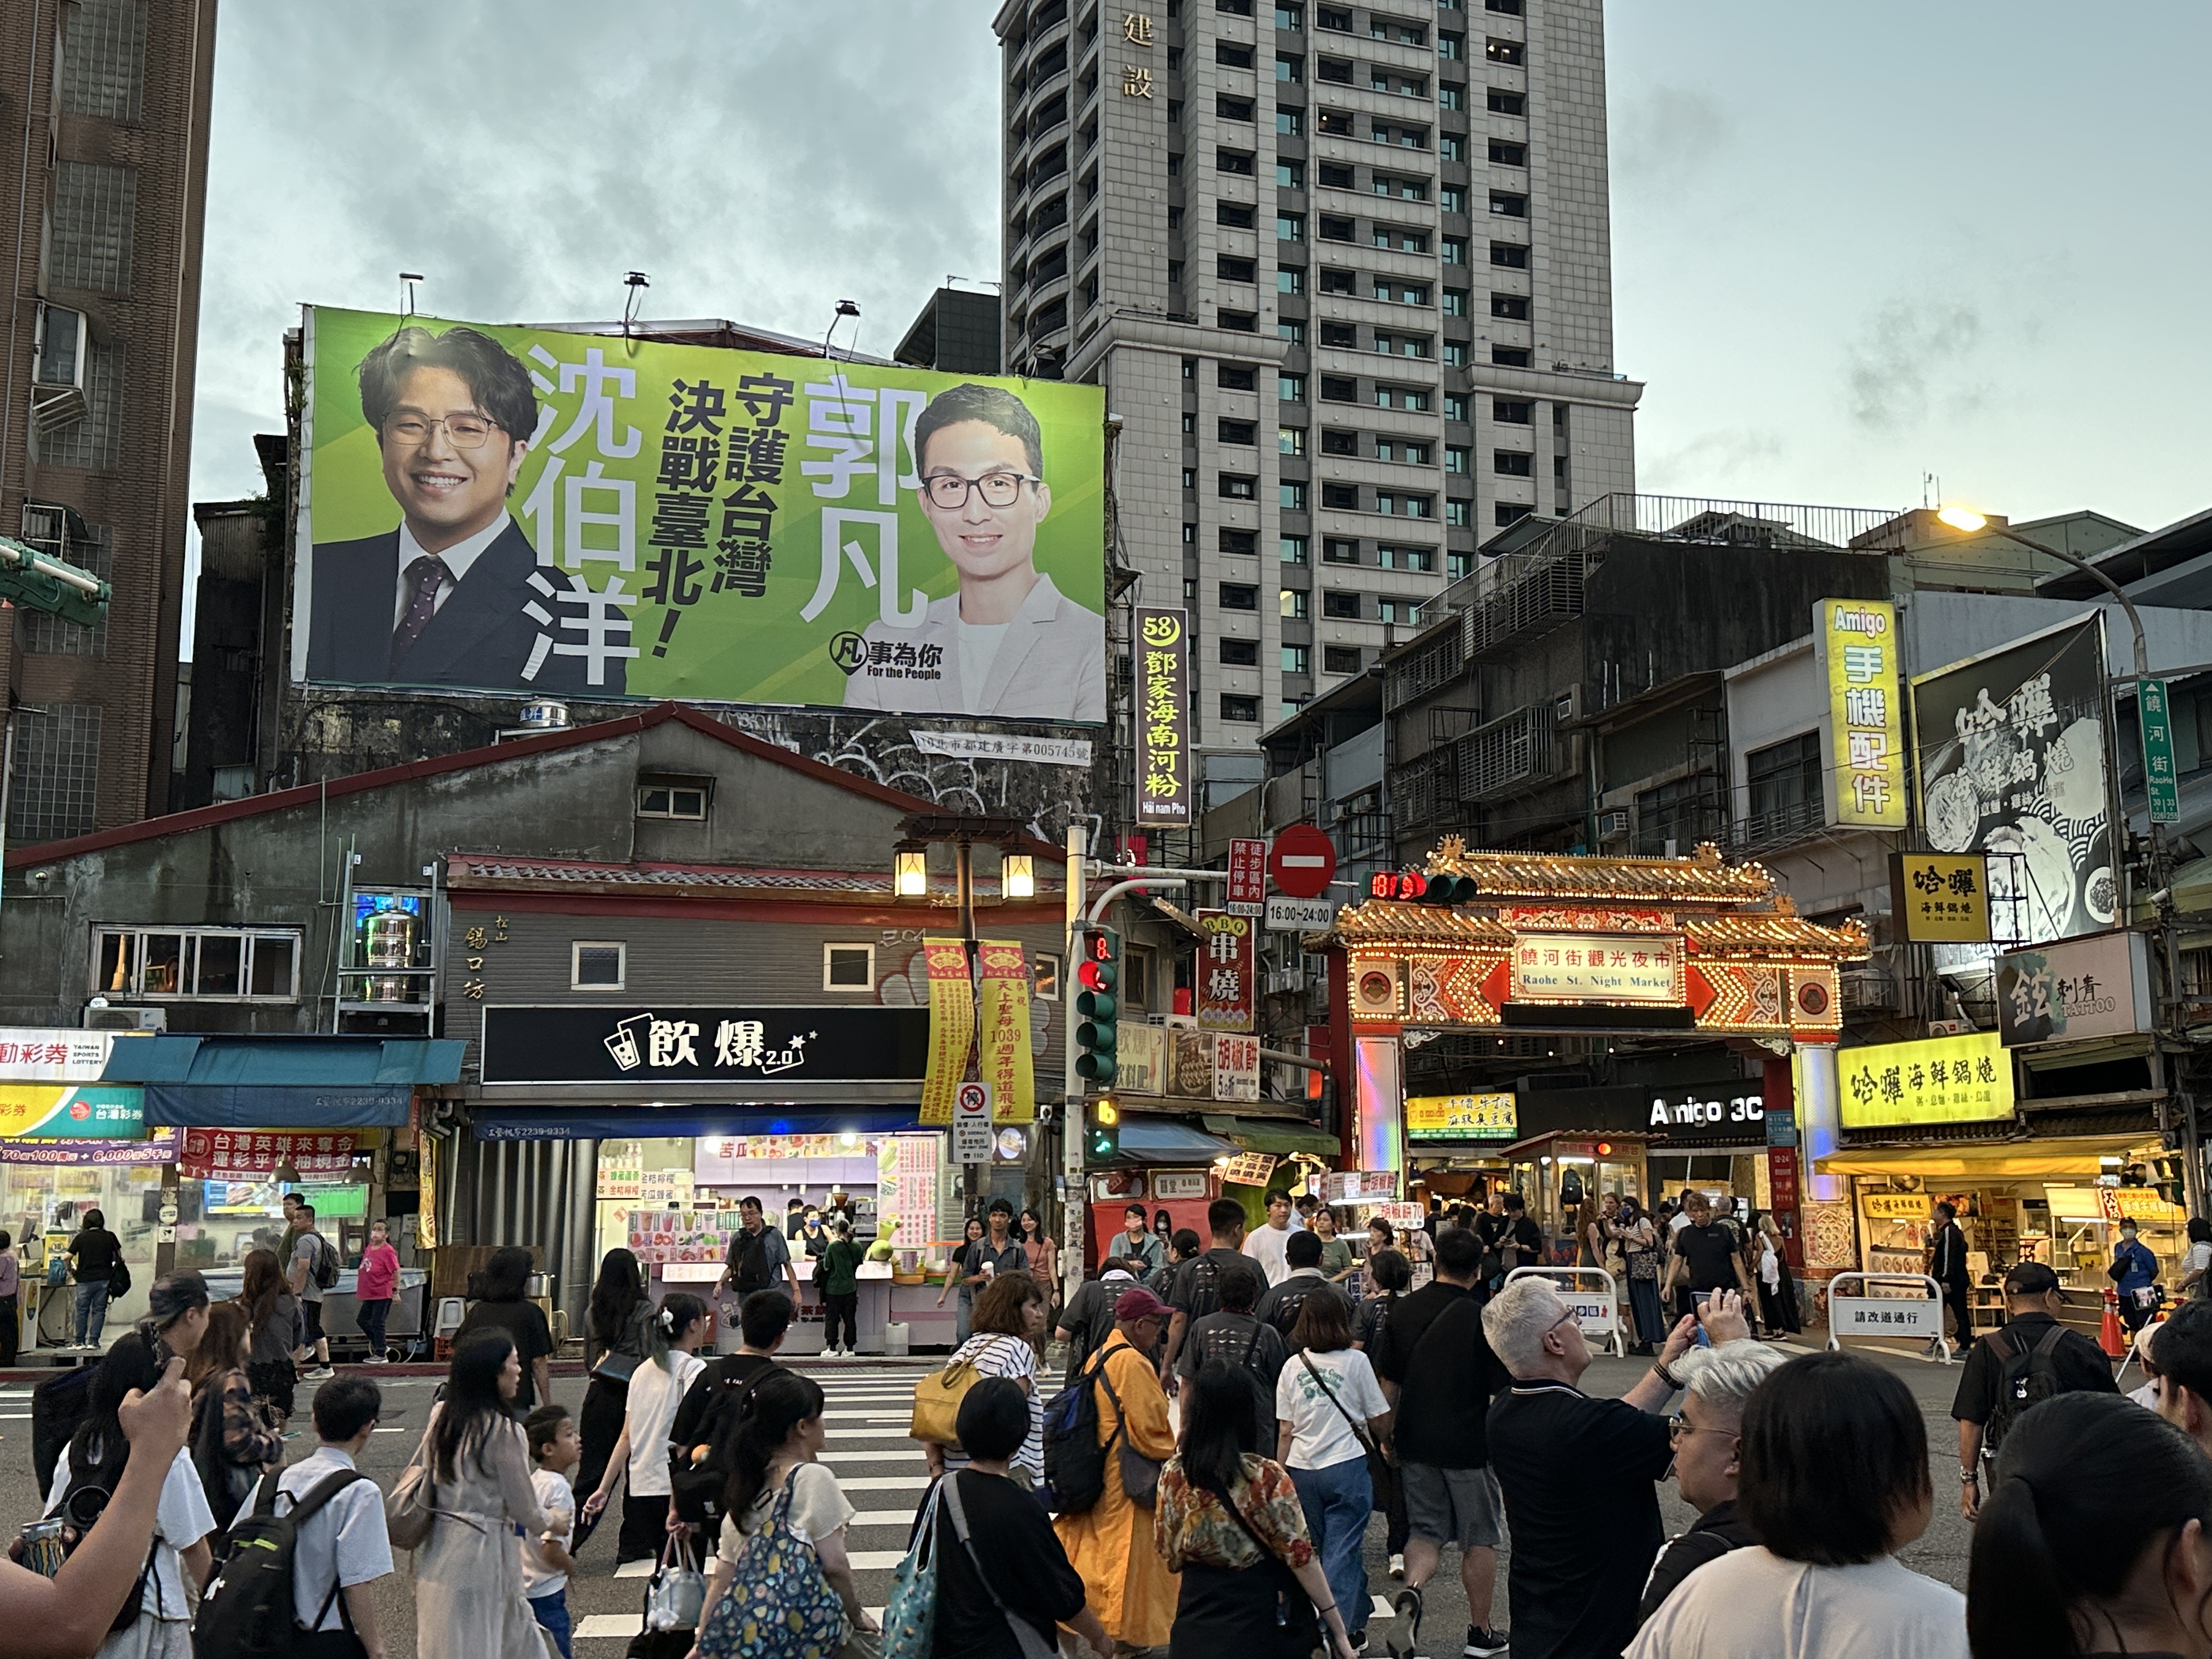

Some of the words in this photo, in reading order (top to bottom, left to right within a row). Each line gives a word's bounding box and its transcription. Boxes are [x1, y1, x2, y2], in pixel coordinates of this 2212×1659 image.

[1122, 13, 1153, 99] 建設
[709, 372, 795, 598] 守護台灣
[799, 373, 928, 629] 郭凡
[519, 343, 642, 685] 沈伯洋
[641, 380, 727, 659] 決戰臺北!
[1143, 616, 1172, 637] 58
[1833, 605, 1886, 639] Amigo
[867, 664, 884, 677] For
[885, 667, 903, 679] the
[904, 668, 941, 680] People
[1143, 651, 1182, 798] 鄧家海南河粉
[1843, 644, 1891, 815] 手機配件
[2145, 695, 2168, 773] 饒河街
[1950, 737, 2075, 802] 海鮮鍋燒
[2151, 787, 2160, 795] St.
[2167, 799, 2175, 807] 33
[1155, 804, 1171, 815] nam
[1172, 802, 1186, 815] Pho
[1232, 842, 1246, 898] 禁止停車
[1248, 843, 1262, 899] 徒步區內
[1270, 906, 1329, 923] 16:00~24:00
[1921, 901, 1973, 915] 海鮮鍋燒
[495, 915, 509, 943] 松山
[1205, 918, 1244, 934] BBQ
[1208, 932, 1240, 1001] 串燒
[1520, 947, 1671, 969] 饒河街觀光夜市
[1522, 974, 1558, 985] Raohe
[1566, 975, 1583, 986] St.
[1590, 975, 1622, 988] Night
[1629, 977, 1671, 988] Market
[2056, 974, 2102, 1003] 刺青
[2061, 996, 2116, 1018] TATTOO
[0, 1042, 69, 1064] 動彩券
[649, 1019, 766, 1068] 飲爆
[1217, 1037, 1257, 1073] 胡椒餅
[766, 1050, 792, 1066] 2.0
[96, 1109, 143, 1120] 台灣彩券
[1445, 1094, 1512, 1110] 平價牛排
[1650, 1096, 1726, 1128] Amigo
[1730, 1096, 1763, 1121] 3C
[1447, 1110, 1514, 1127] 麻辣臭豆腐
[213, 1132, 355, 1152] 台灣英雄來奪金
[1854, 1311, 1918, 1324] 請改道通行
